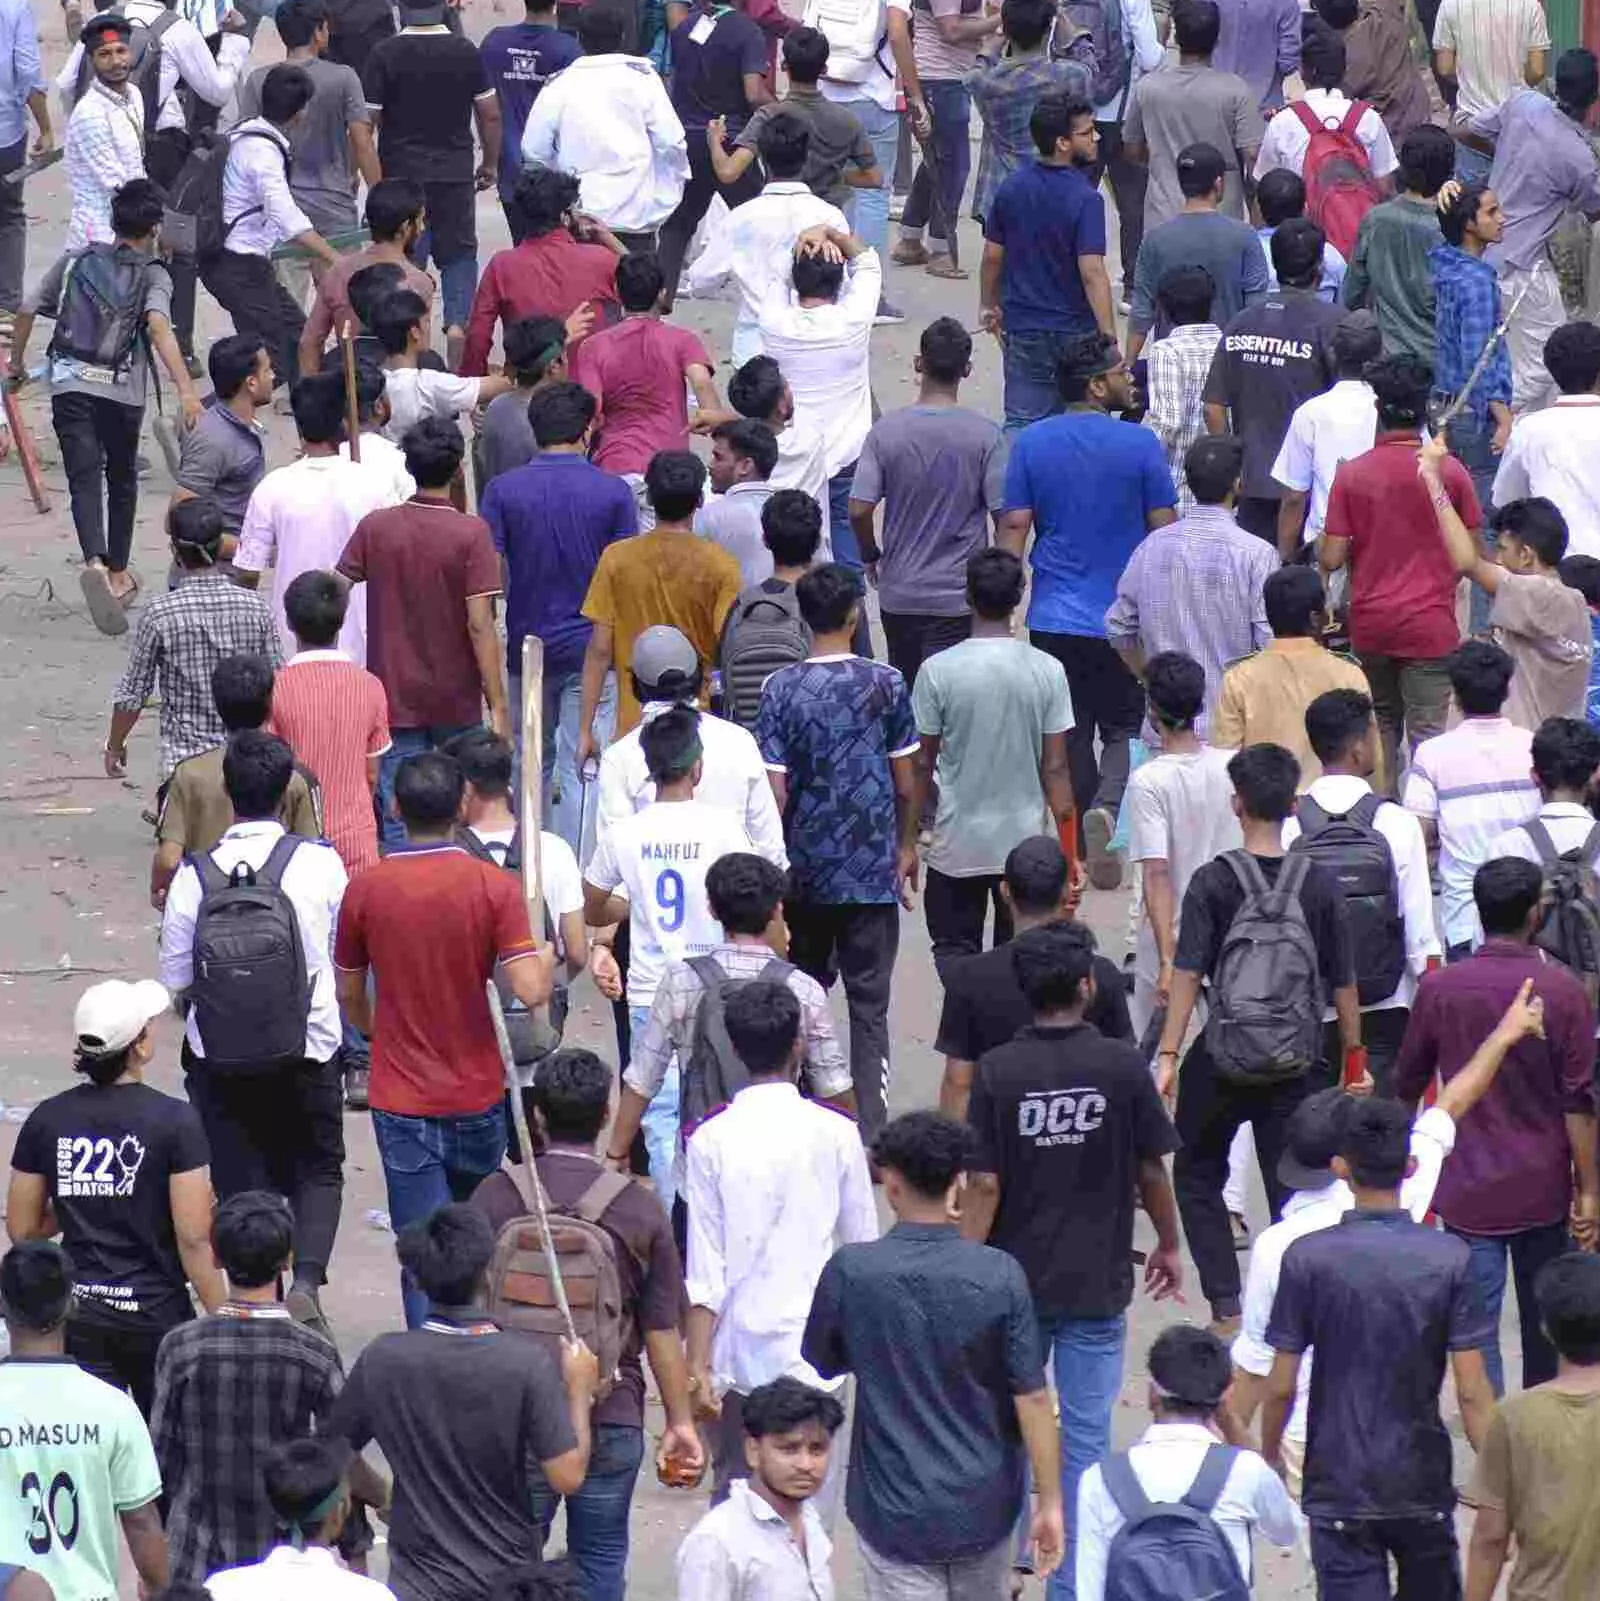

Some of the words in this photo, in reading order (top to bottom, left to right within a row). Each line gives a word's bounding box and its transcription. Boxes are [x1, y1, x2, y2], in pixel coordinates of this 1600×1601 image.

[1225, 334, 1313, 359] ESSENTIALS
[656, 867, 685, 933] 9
[1019, 1094, 1106, 1136] DCC
[72, 1136, 114, 1182] 22
[72, 1182, 114, 1197] BATCH
[20, 1470, 80, 1555] 30
